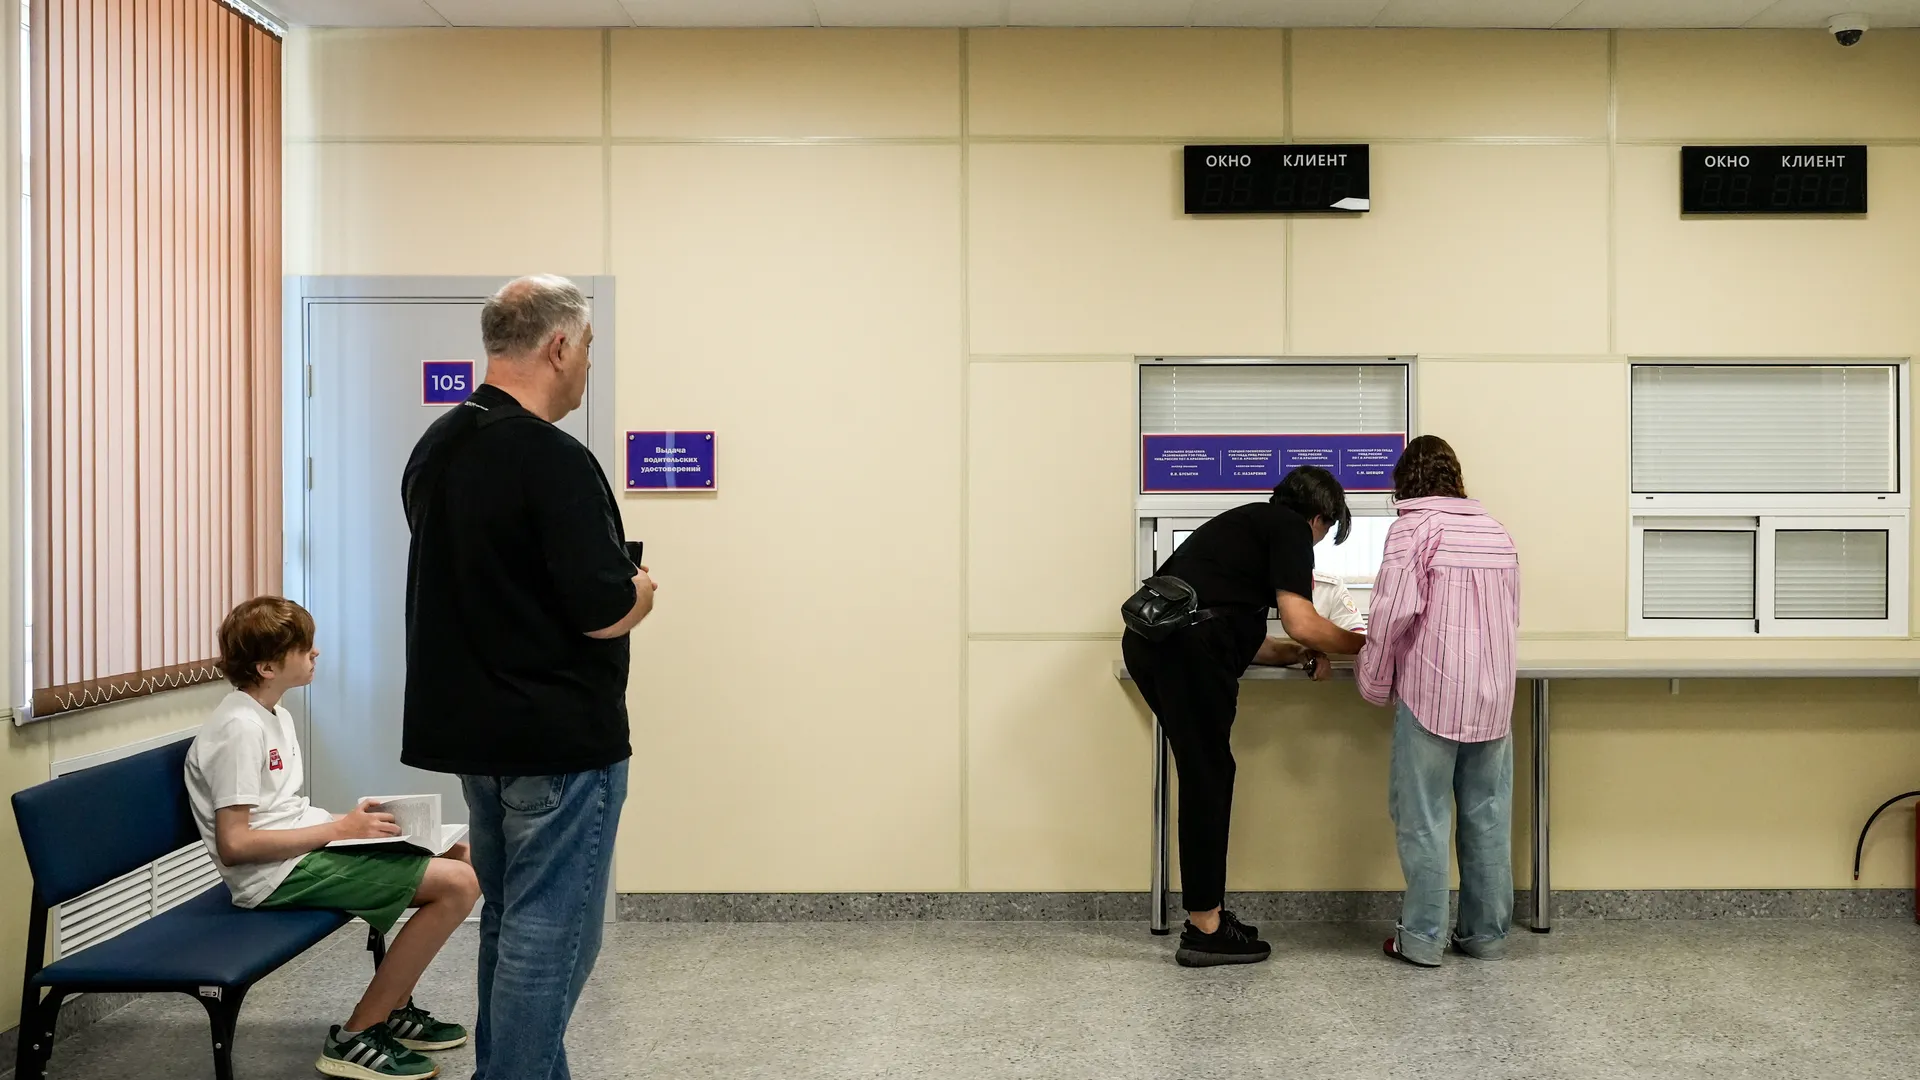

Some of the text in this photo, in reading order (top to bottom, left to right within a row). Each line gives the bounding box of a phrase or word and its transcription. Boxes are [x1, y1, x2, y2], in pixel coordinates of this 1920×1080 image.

[1205, 154, 1348, 167] ОКНО КЛИЕНТ
[1704, 155, 1846, 168] ОКНО КЛИЕНТ
[431, 374, 466, 391] 105
[655, 446, 687, 455] Выдача
[643, 456, 698, 464] водительских
[640, 465, 701, 474] удостоверений
